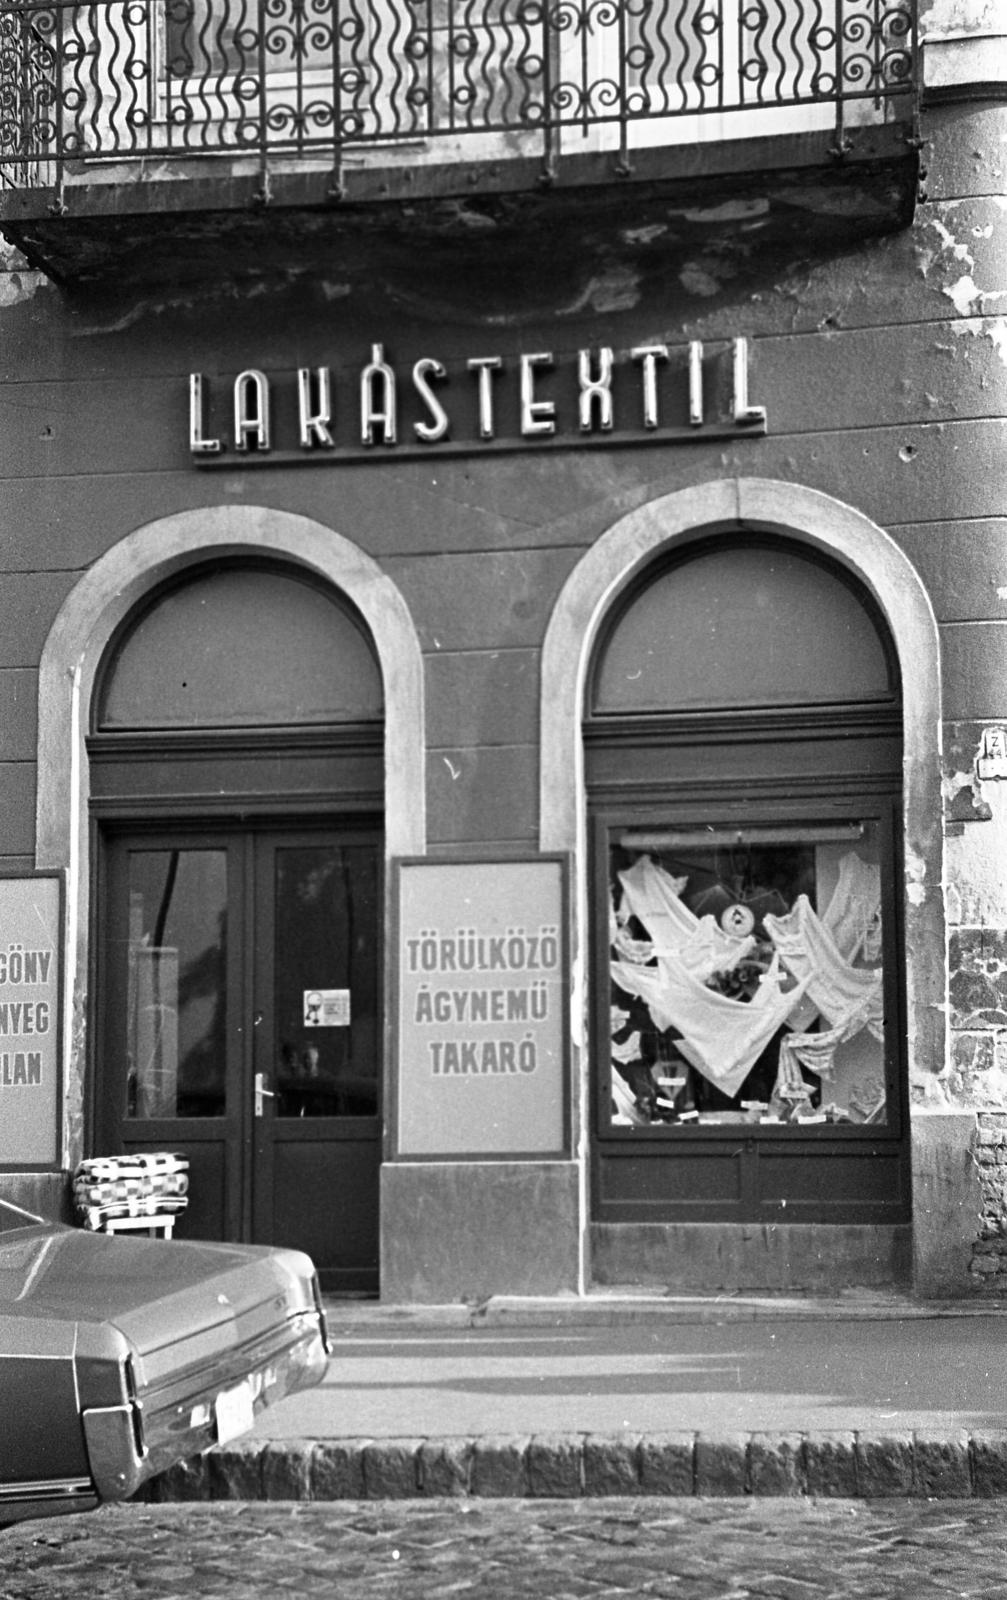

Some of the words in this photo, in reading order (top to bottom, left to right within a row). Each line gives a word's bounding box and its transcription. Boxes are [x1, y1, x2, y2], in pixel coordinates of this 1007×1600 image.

[189, 338, 767, 452] LAKÁSTEXTIL
[0, 1002, 49, 1034] NYEG
[0, 1052, 41, 1085] LAN
[430, 1033, 537, 1074] TAKARÓ
